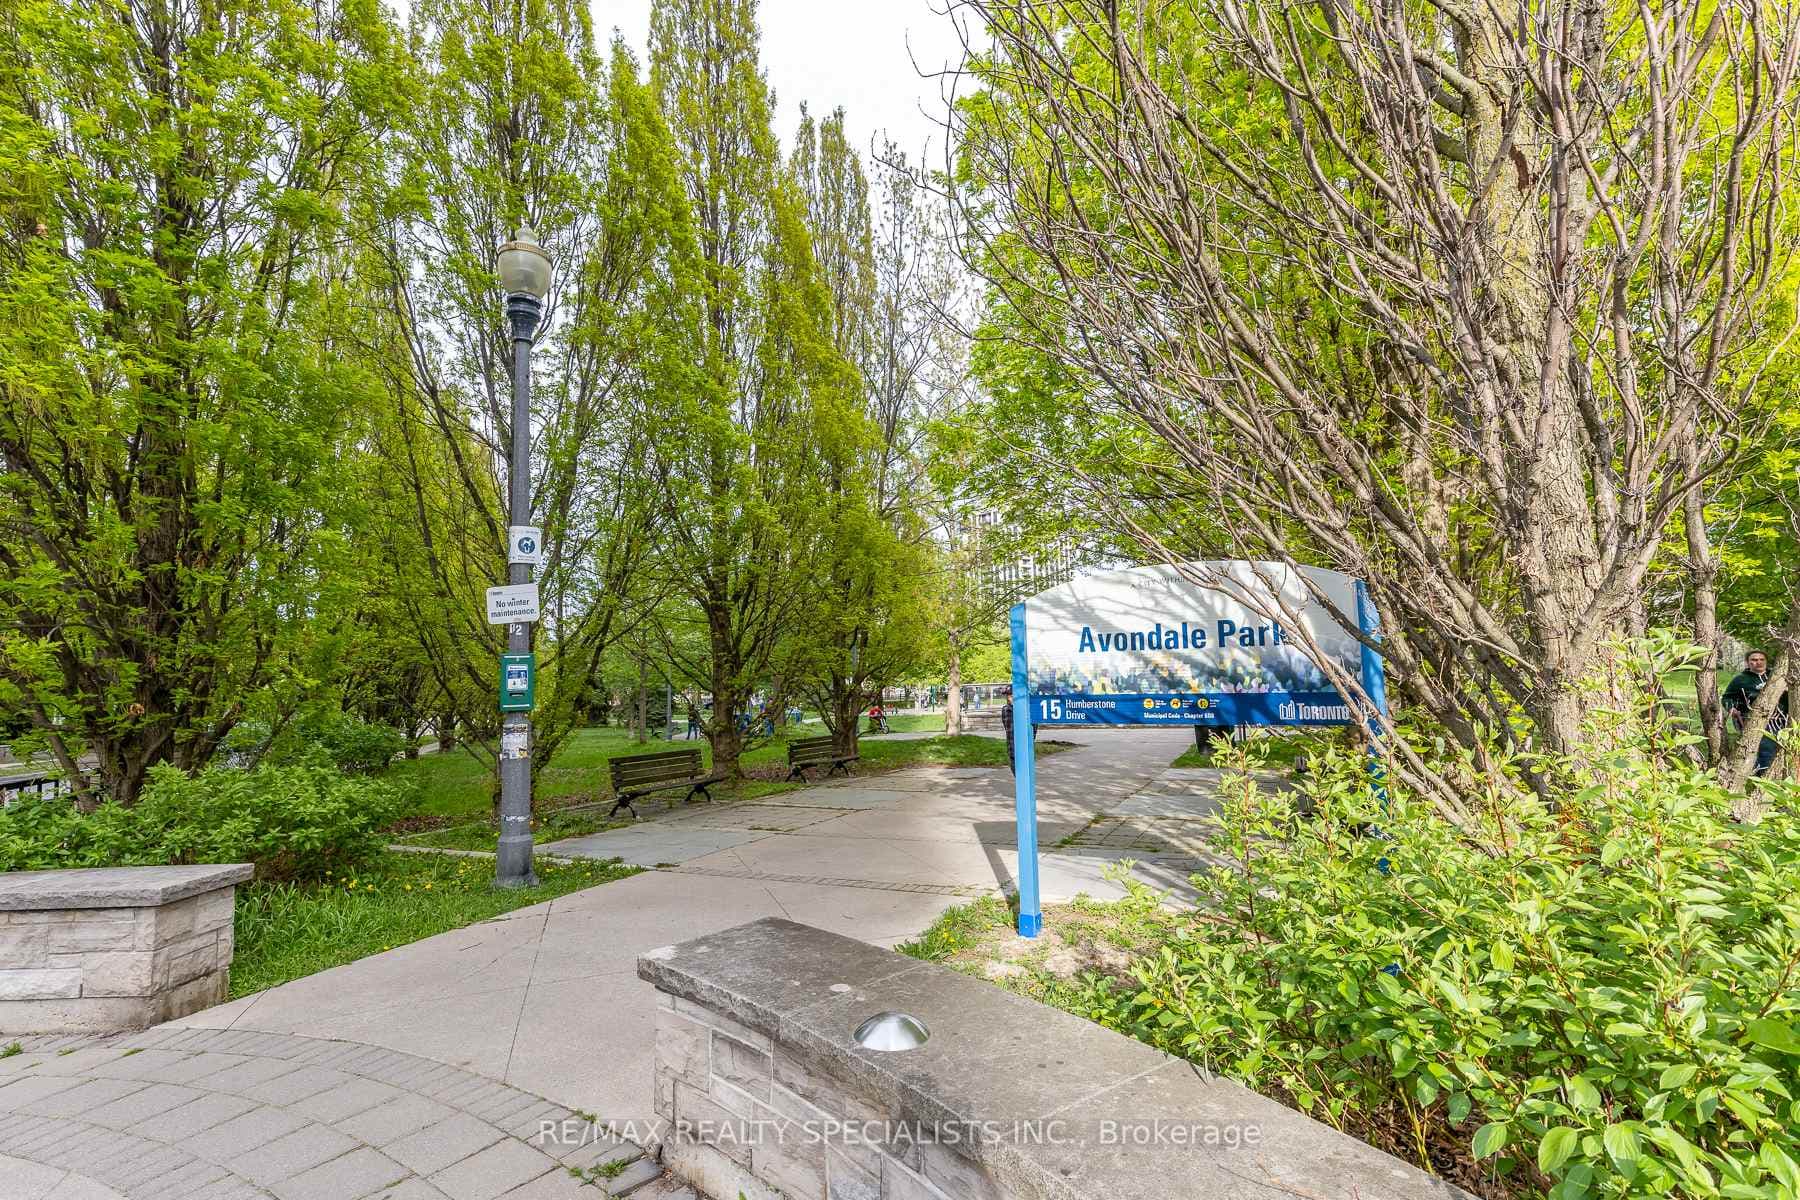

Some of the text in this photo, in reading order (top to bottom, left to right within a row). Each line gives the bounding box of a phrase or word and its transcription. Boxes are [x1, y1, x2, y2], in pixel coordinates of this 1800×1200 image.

[507, 598, 530, 607] winter
[1079, 622, 1206, 653] Avondale
[1065, 699, 1116, 709] Humberstone
[1040, 699, 1062, 720] 15
[1065, 710, 1086, 720] Drive
